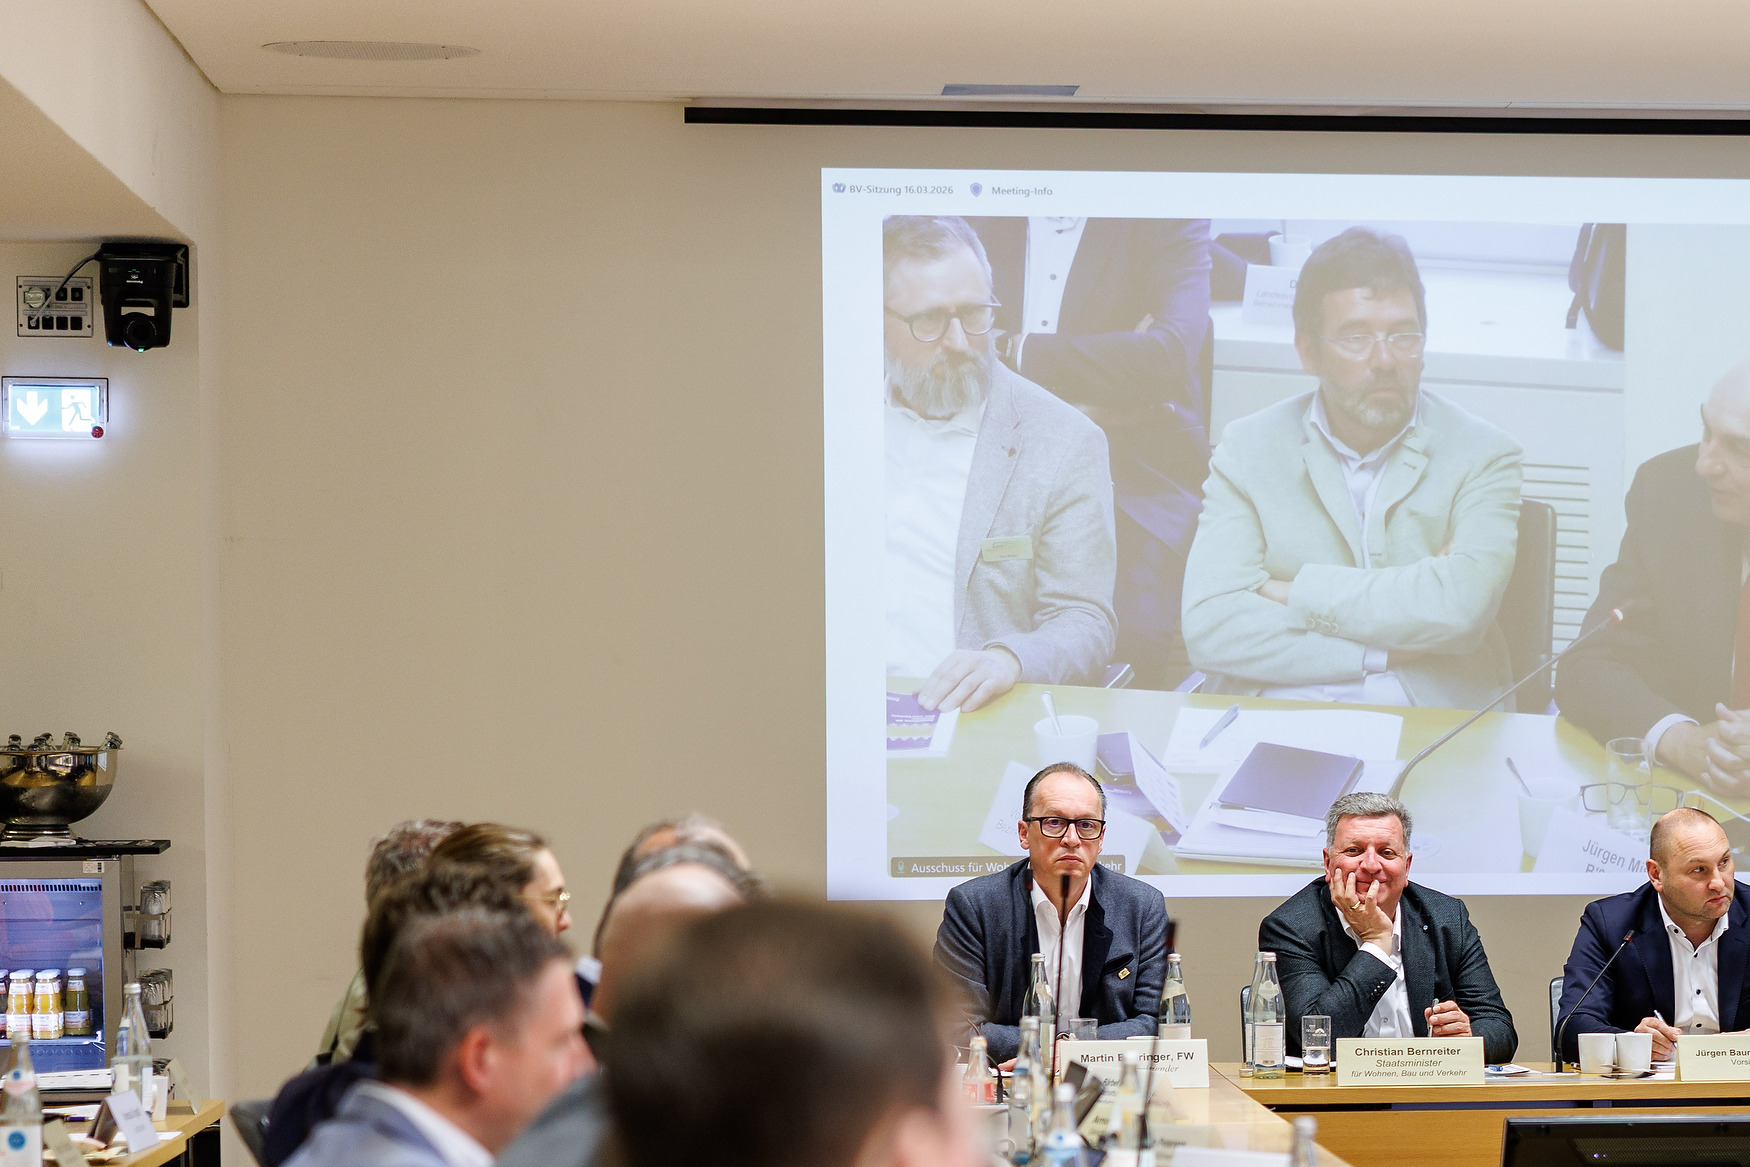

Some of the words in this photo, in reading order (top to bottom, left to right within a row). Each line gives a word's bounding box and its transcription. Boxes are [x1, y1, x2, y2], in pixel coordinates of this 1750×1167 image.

[849, 185, 901, 196] BV-Sitzung
[904, 185, 954, 195] 16.03.2026
[991, 186, 1053, 197] Meeting-Info
[1582, 839, 1625, 868] Jürgen
[911, 863, 965, 873] Ausschuss
[968, 862, 983, 873] für
[1080, 1053, 1114, 1063] Martin
[1176, 1051, 1195, 1061] FW
[1354, 1047, 1404, 1057] Christian
[1407, 1046, 1461, 1056] Bernreiter
[1695, 1049, 1727, 1059] Jürgen
[1376, 1059, 1443, 1068] Staatsminister
[1351, 1070, 1362, 1078] für
[1364, 1069, 1399, 1078] Wohnen,
[1401, 1069, 1417, 1077] Bau
[1419, 1069, 1434, 1077] und
[1437, 1069, 1468, 1077] Verkehr
